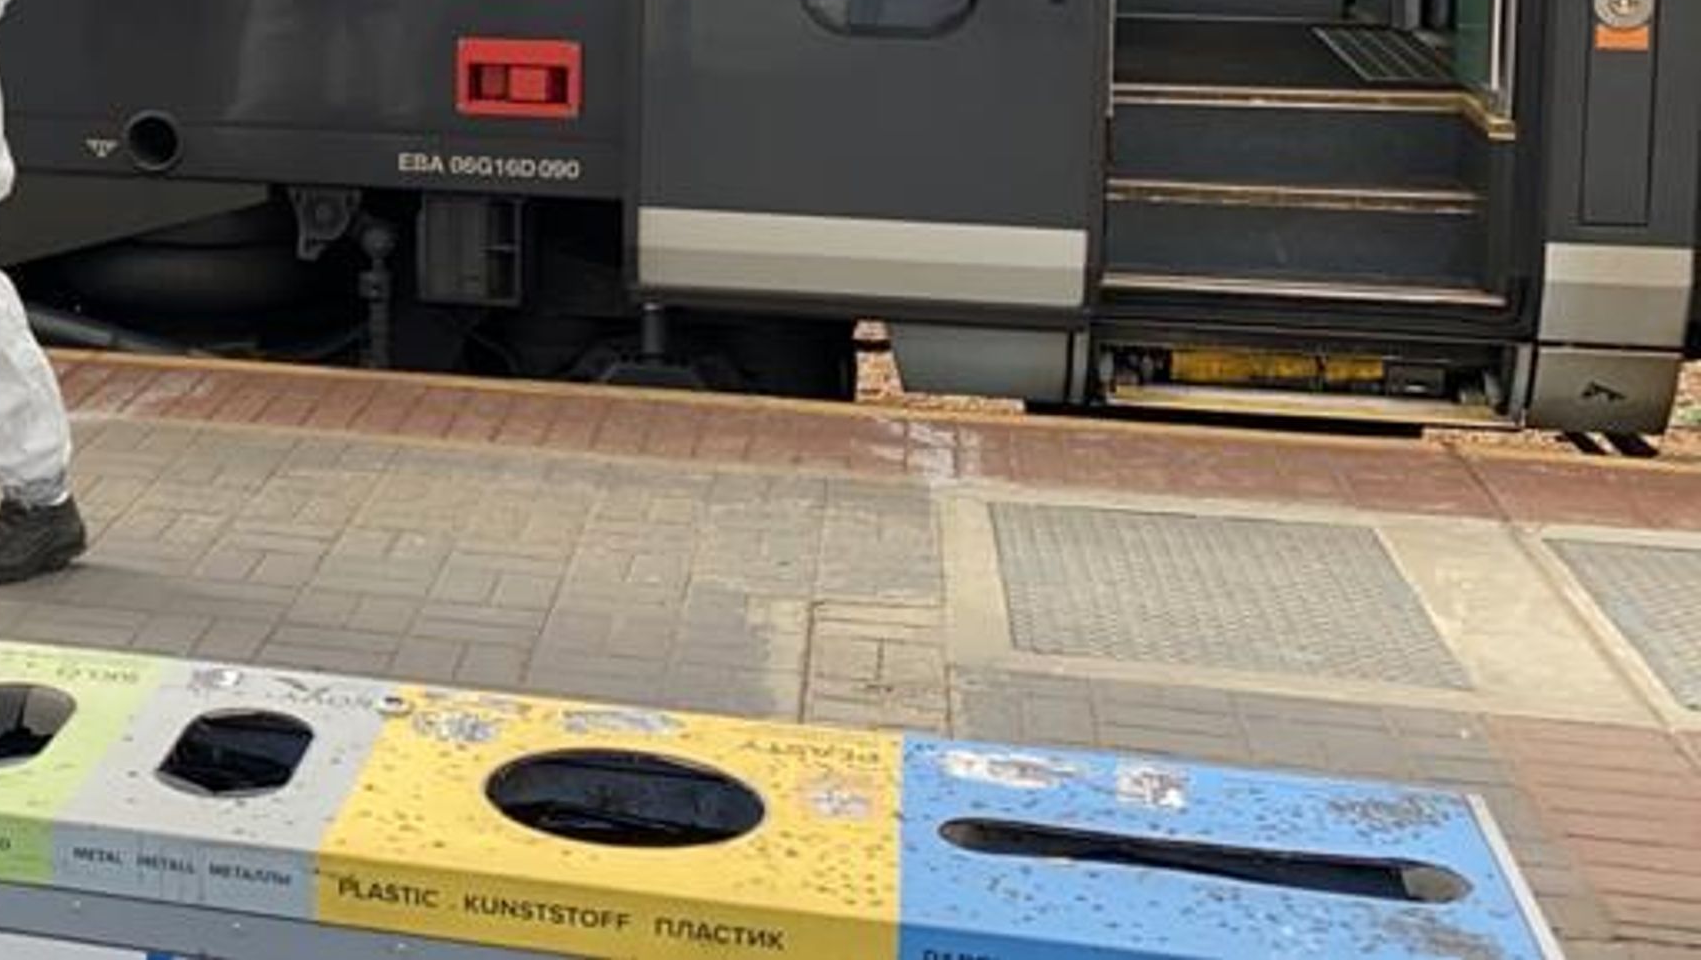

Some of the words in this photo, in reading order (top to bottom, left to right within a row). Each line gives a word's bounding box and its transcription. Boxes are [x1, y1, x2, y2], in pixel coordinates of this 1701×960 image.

[398, 152, 443, 172] EBA
[338, 875, 440, 909] PLASTIC
[463, 892, 630, 930] KUNSTSTOFF
[653, 916, 786, 950] ПЛАСТИК
